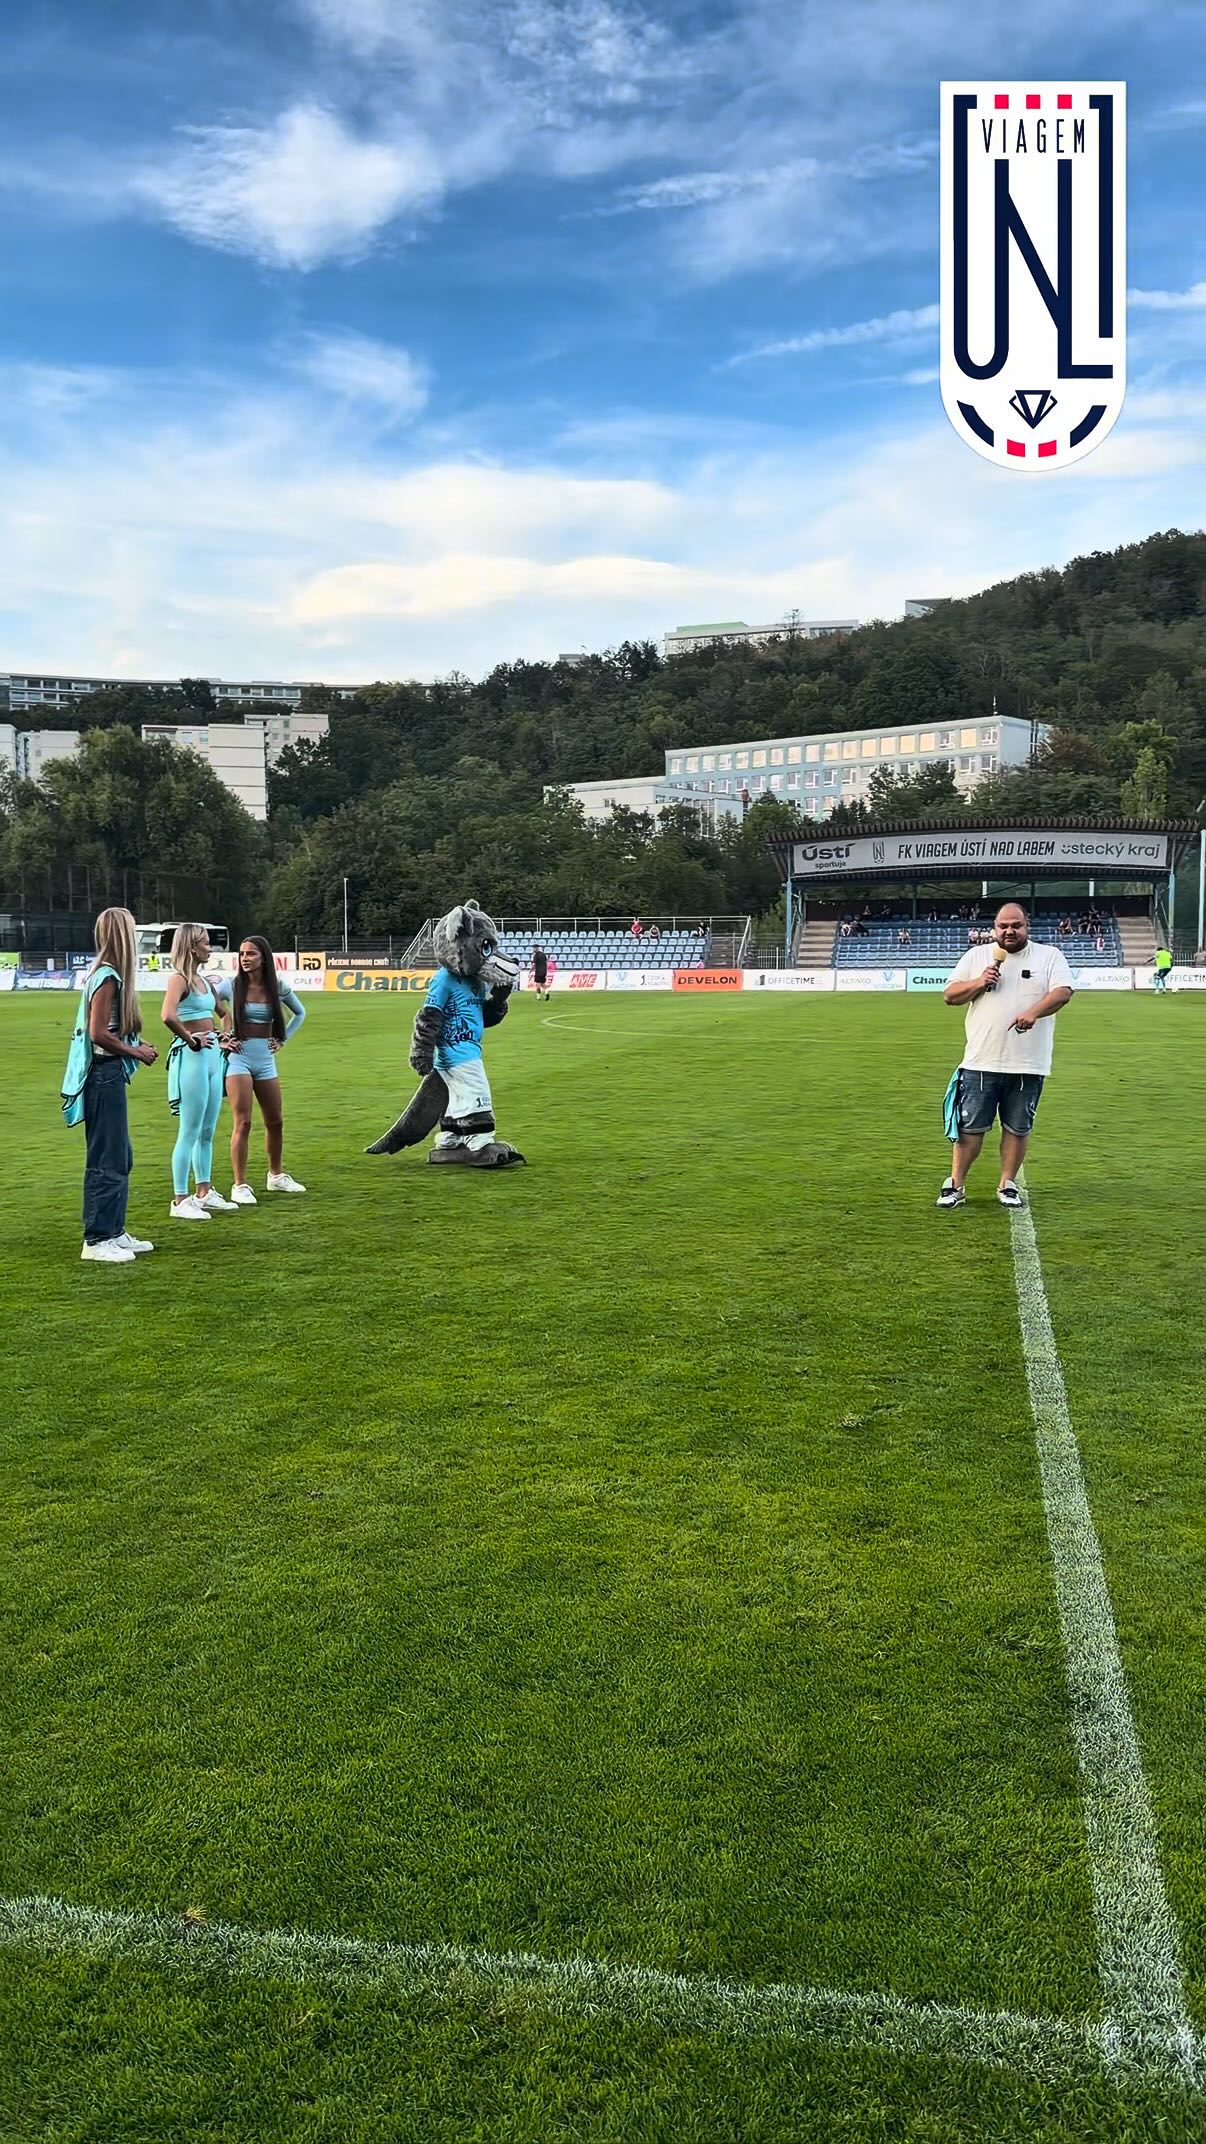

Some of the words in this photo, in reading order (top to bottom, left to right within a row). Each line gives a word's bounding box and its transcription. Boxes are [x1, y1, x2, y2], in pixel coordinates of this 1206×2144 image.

[898, 845, 912, 859] FK
[915, 843, 957, 858] VIAGEM
[960, 839, 987, 856] ÚSTÍ
[990, 841, 1014, 856] NAD
[1017, 841, 1055, 856] LABEM
[1128, 843, 1160, 859] kraj
[815, 861, 847, 869] sportuje
[678, 976, 737, 985] DEVELON
[767, 977, 815, 985] OFFICETIME
